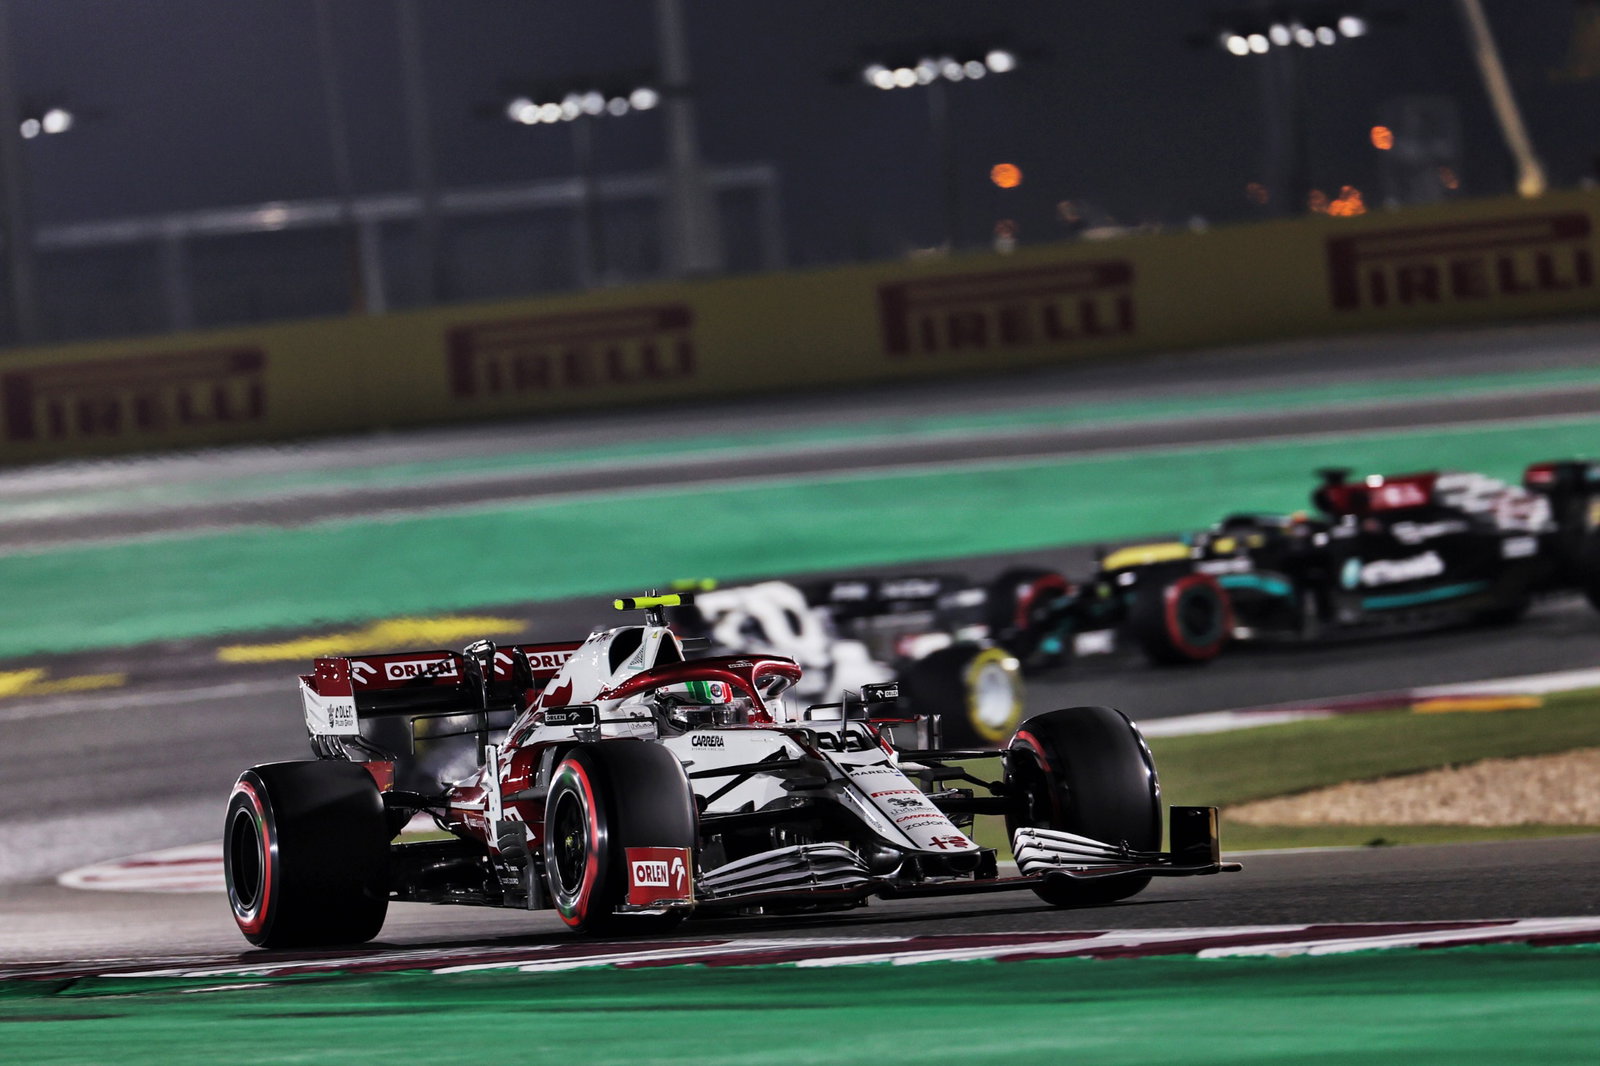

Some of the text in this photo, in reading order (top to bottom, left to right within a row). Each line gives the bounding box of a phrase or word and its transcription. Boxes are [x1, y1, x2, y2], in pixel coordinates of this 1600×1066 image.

[1325, 212, 1593, 310] PIRELLI
[877, 259, 1136, 357] PIRELLI
[446, 302, 693, 399] PIRELLI
[1, 346, 265, 442] PIRELLI
[389, 661, 453, 678] ORLEN
[528, 653, 573, 669] ORL
[691, 735, 725, 747] CARRERA
[636, 864, 667, 883] ORLEN
